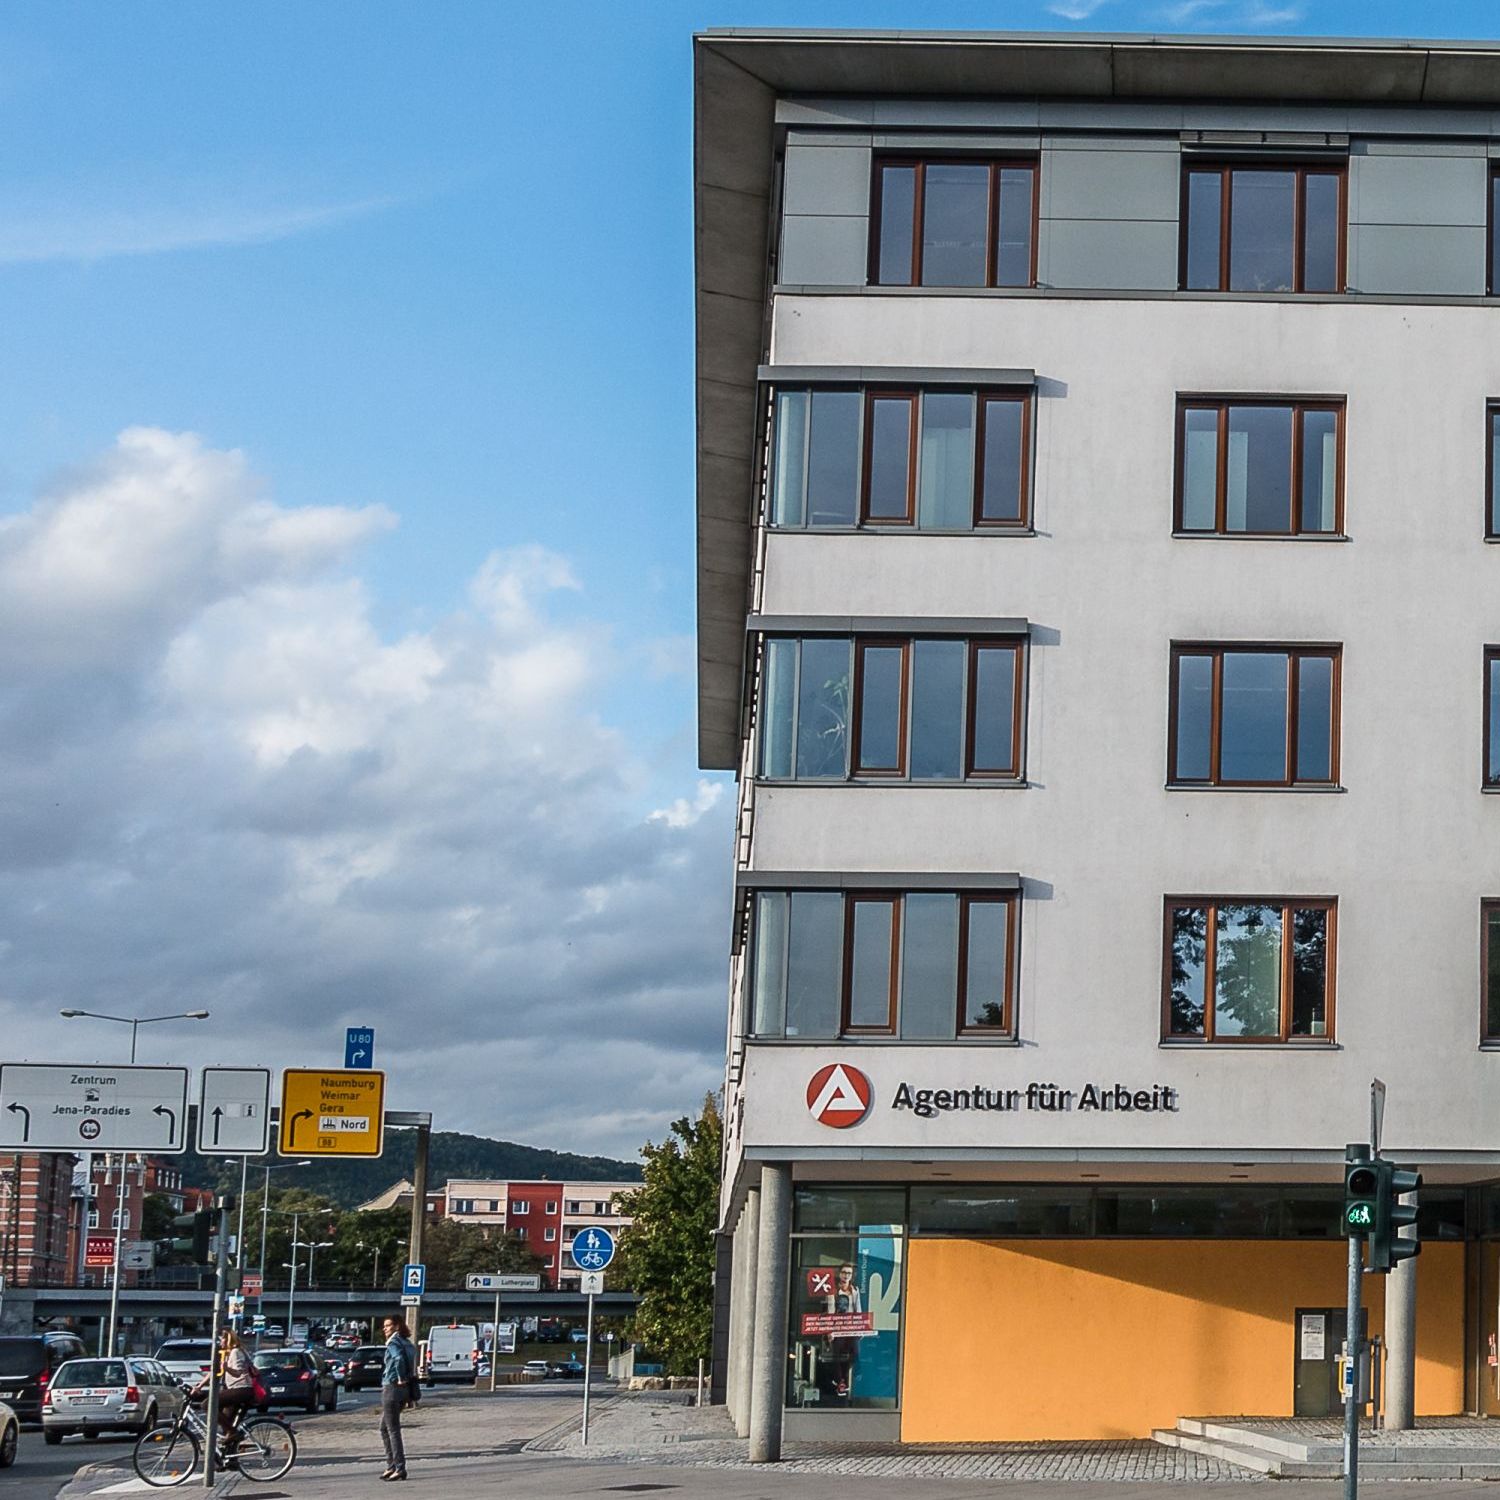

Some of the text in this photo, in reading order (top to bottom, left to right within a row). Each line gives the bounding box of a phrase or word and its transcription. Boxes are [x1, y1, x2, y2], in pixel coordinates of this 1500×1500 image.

[350, 1034, 371, 1043] U 80
[70, 1074, 117, 1085] Zentrum
[320, 1078, 376, 1090] Naumburg
[320, 1090, 361, 1100] Weimar
[891, 1082, 1173, 1116] Agentur für Arbeit
[52, 1104, 131, 1116] Jena-Paradies
[319, 1103, 345, 1113] Gera
[340, 1119, 367, 1129] Nord
